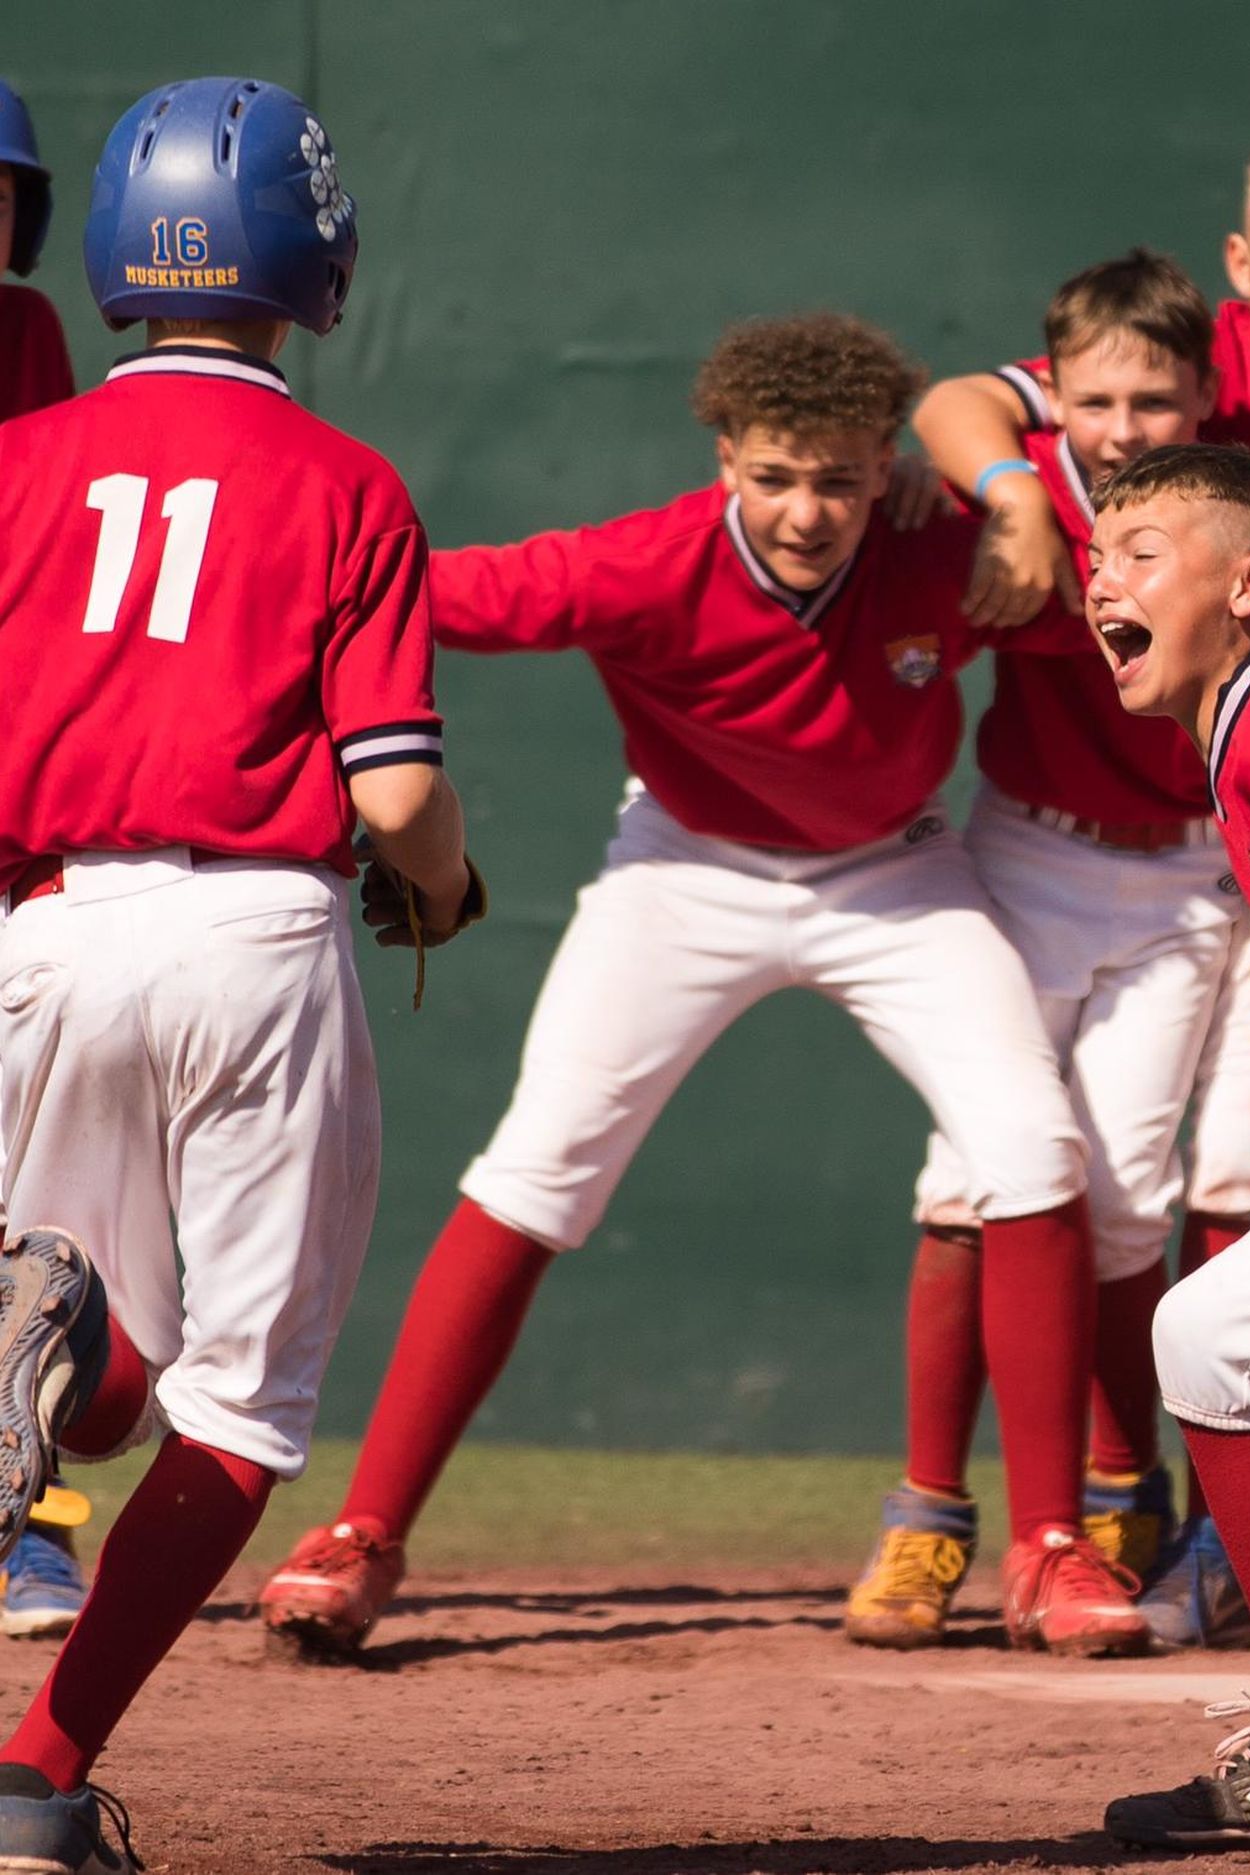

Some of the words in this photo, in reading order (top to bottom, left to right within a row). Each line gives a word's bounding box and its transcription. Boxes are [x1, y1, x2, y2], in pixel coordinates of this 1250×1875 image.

[151, 217, 208, 266] 16
[125, 264, 239, 287] MUSKETEERS
[82, 473, 219, 644] 11
